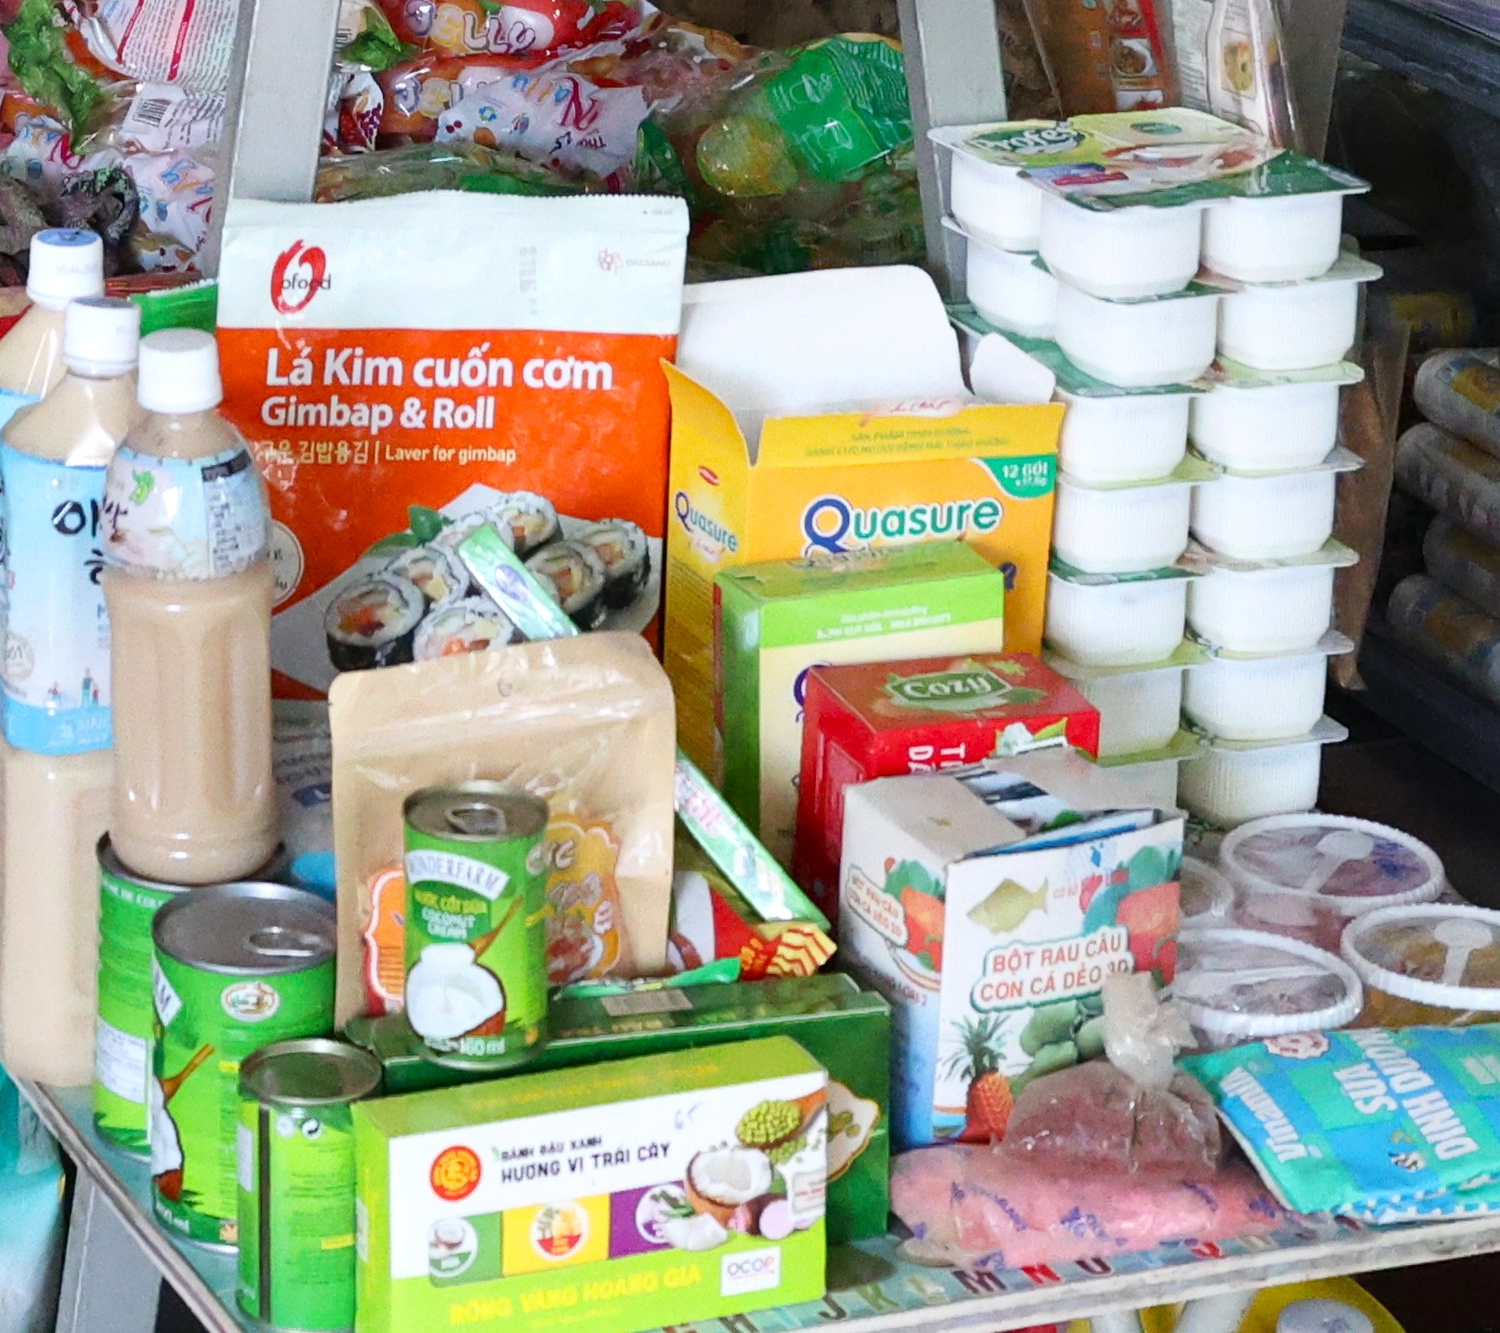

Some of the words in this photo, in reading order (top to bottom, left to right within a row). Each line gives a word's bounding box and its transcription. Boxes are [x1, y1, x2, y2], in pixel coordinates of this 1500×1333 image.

[266, 344, 316, 388] Lá
[324, 346, 402, 388] Kim
[412, 333, 514, 389] cuốn
[523, 355, 613, 390] cơm
[261, 395, 393, 441] Gimbap
[399, 399, 428, 429] &
[434, 396, 496, 430] Roll
[385, 443, 428, 464] Laver
[433, 443, 457, 463] for
[460, 444, 517, 467] gimbap
[674, 491, 738, 553] Quasure
[802, 495, 1003, 558] Quasure
[902, 675, 992, 700] Cozy
[421, 906, 476, 928] COCONUT
[992, 952, 1032, 975] BỘT
[1041, 943, 1078, 967] RAU
[1085, 931, 1121, 958] CÂU
[980, 979, 1025, 1001] CON
[1029, 973, 1057, 995] CÁ
[1064, 964, 1103, 990] DẺO
[1332, 1062, 1400, 1115] SỮA
[1219, 1066, 1321, 1165] Vinamilk
[1403, 1088, 1482, 1161] DINH
[502, 1160, 561, 1183] HƯƠNG
[568, 1156, 583, 1173] VỊ
[592, 1144, 630, 1168] TRÁI
[637, 1141, 671, 1161] CÂY
[727, 1256, 775, 1275] OCOP
